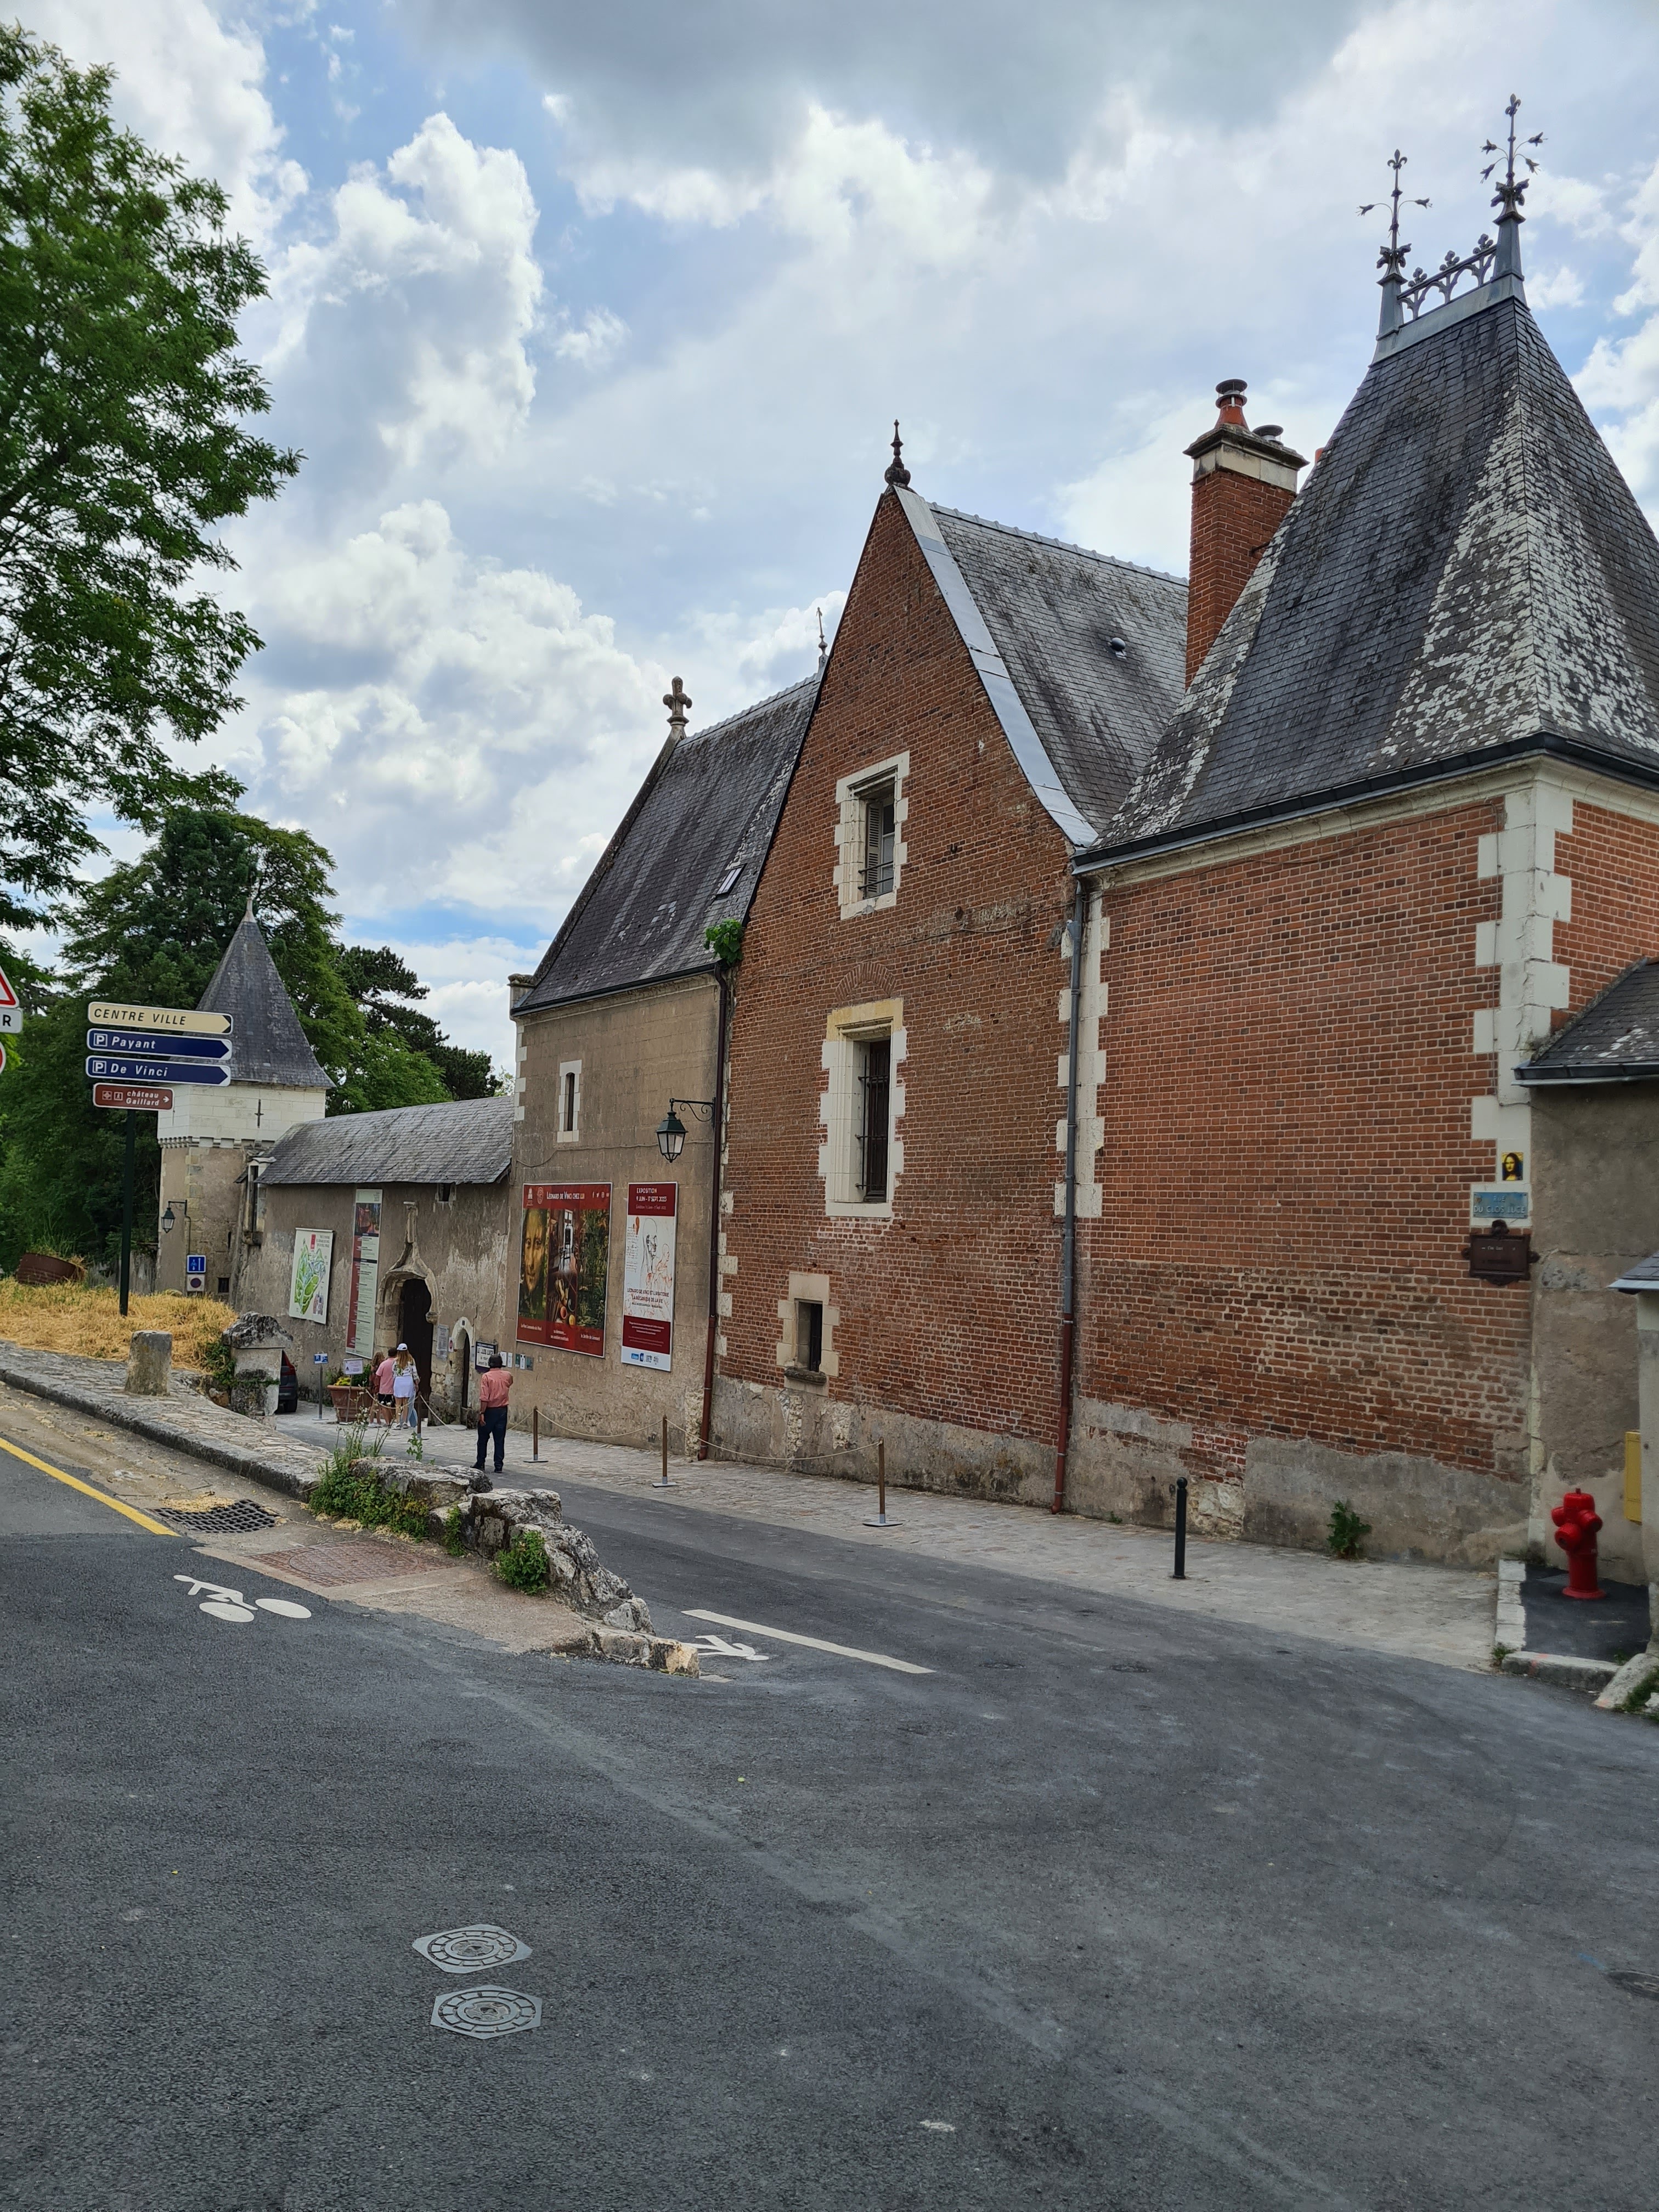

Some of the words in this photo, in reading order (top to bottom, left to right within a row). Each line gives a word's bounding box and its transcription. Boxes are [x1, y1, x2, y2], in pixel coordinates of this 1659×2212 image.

[94, 1008, 144, 1022] CENTRE
[153, 1014, 187, 1025] VILLE
[111, 1036, 155, 1049] Payant
[110, 1063, 127, 1074] De
[136, 1065, 168, 1076] Vinci
[127, 1090, 159, 1098] château
[126, 1097, 160, 1106] Gaillard
